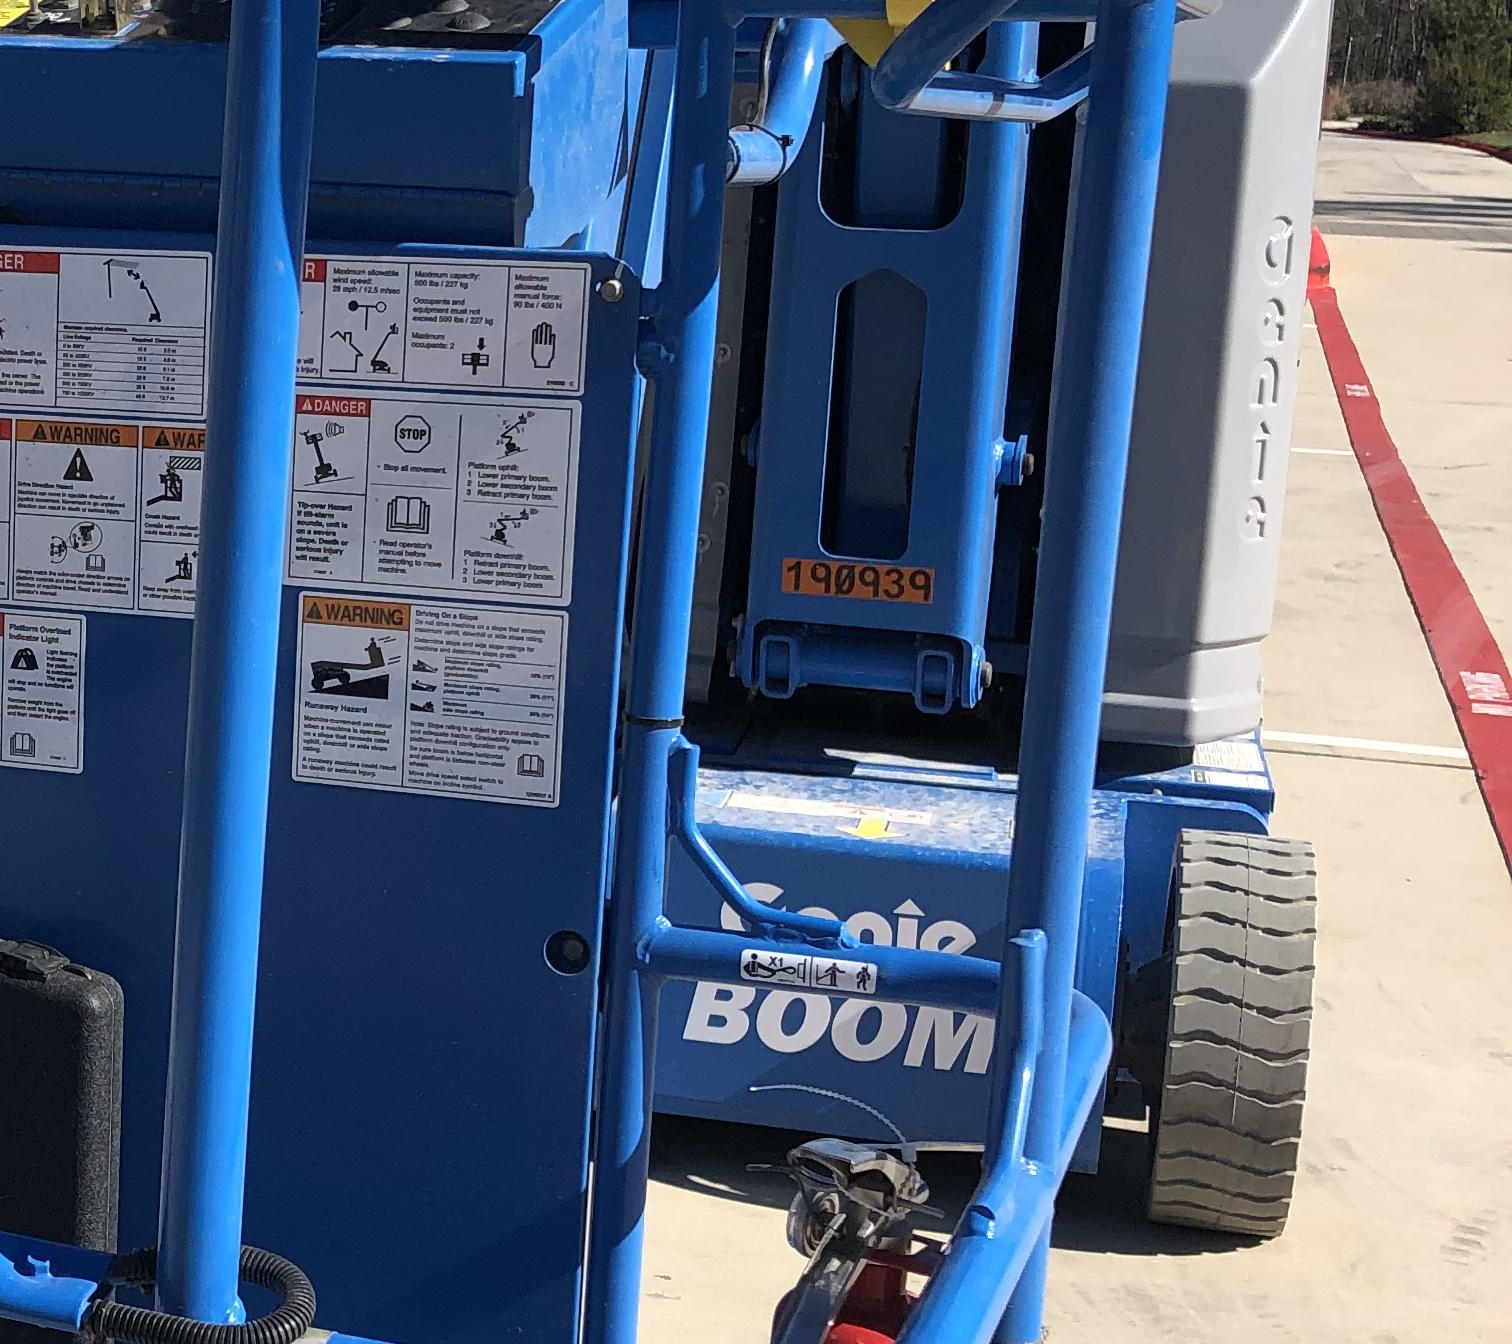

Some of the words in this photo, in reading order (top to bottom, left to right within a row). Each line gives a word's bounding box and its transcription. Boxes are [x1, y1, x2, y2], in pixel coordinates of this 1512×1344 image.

[314, 400, 366, 414] DANGER
[48, 425, 121, 445] WARNING
[399, 428, 427, 440] STOP
[787, 560, 931, 602] 190939
[325, 603, 404, 627] WARNING
[9, 623, 38, 632] Platform
[39, 626, 71, 635] Overload
[9, 632, 39, 642] Indicator
[41, 635, 59, 644] Light
[305, 701, 339, 713] Runaway
[340, 704, 368, 713] Hazard
[768, 955, 784, 967] X1
[683, 980, 996, 1074] BOOM
